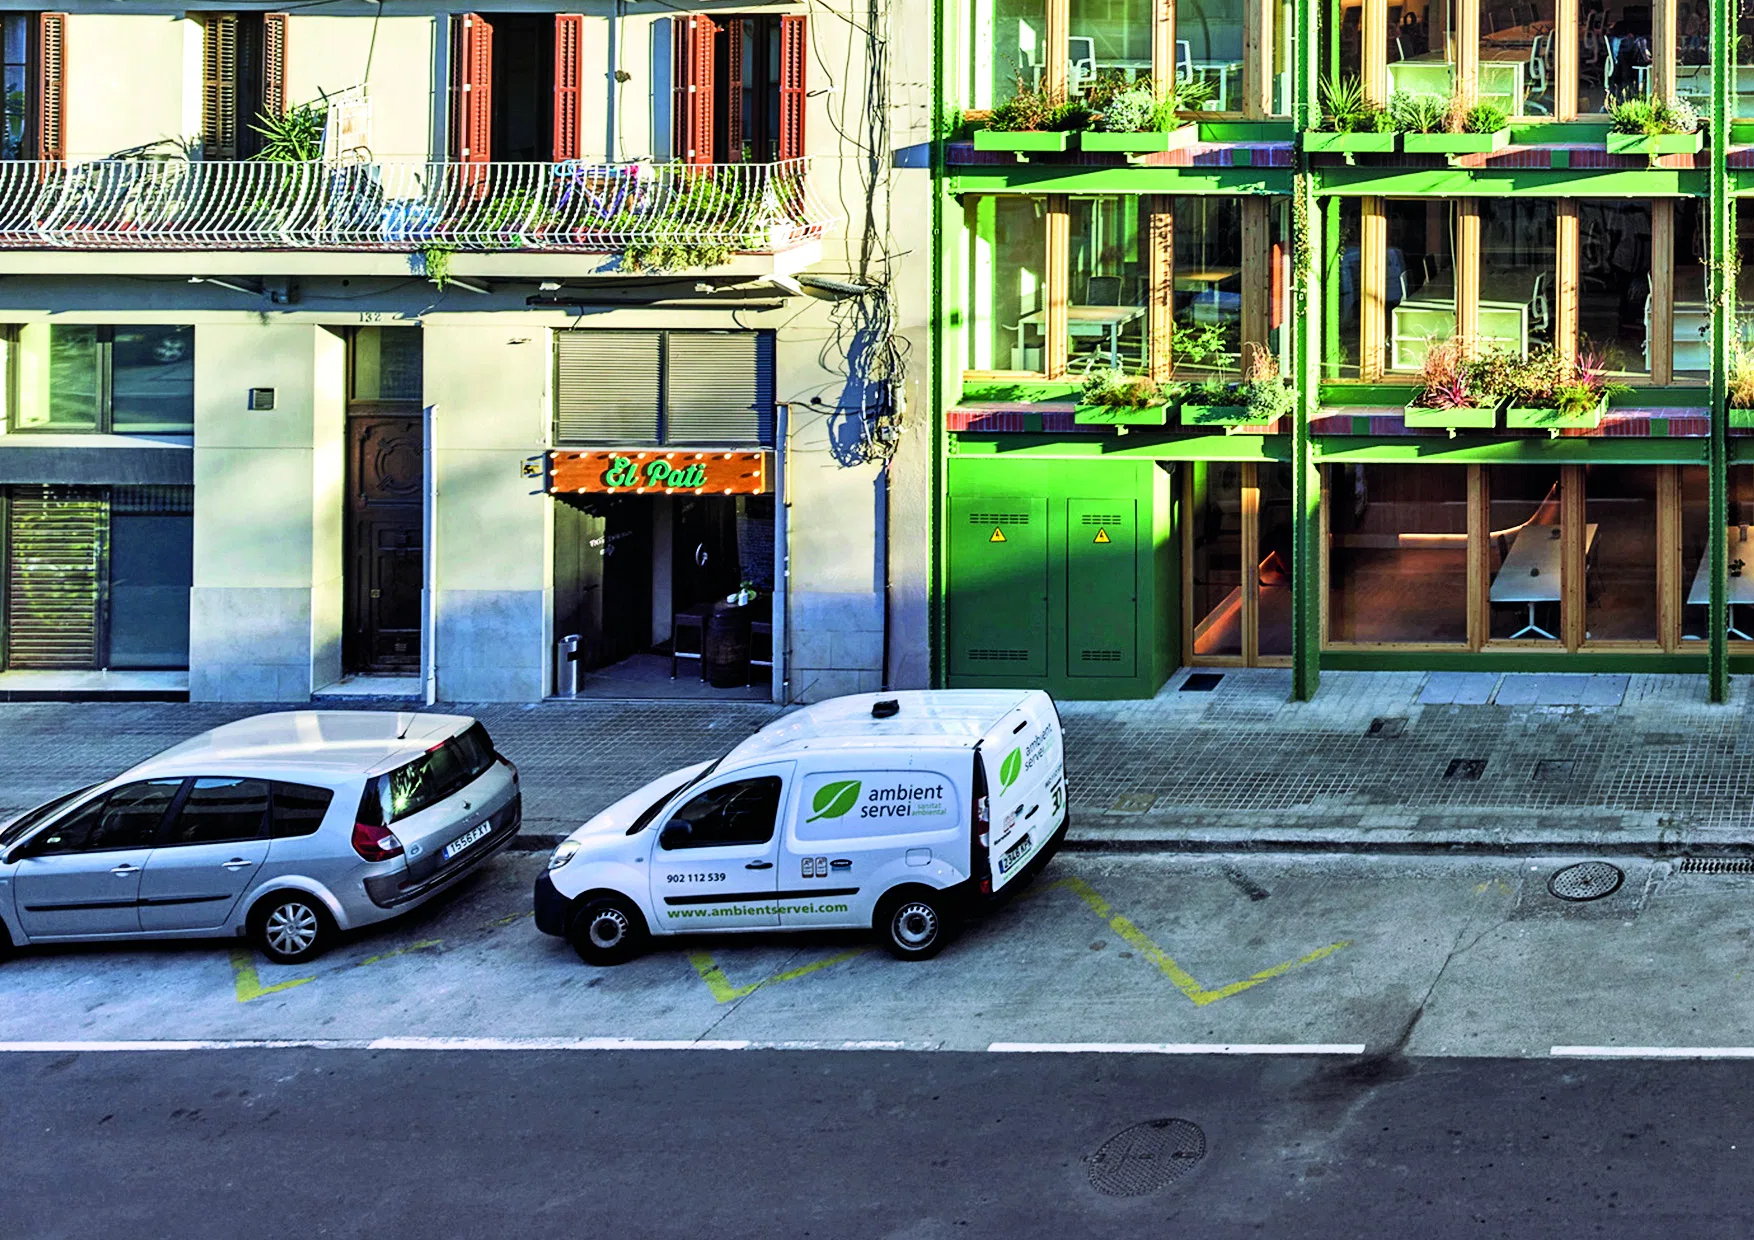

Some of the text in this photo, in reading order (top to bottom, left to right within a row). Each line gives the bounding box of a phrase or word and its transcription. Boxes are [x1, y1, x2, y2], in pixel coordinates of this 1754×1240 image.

[605, 457, 708, 488] El Pati
[1026, 723, 1053, 757] ambient
[868, 784, 944, 802] ambient
[860, 801, 912, 819] servei
[911, 808, 947, 817] ambiental
[666, 872, 726, 883] 902 112 539
[667, 903, 848, 919] www.ambientservei.com
